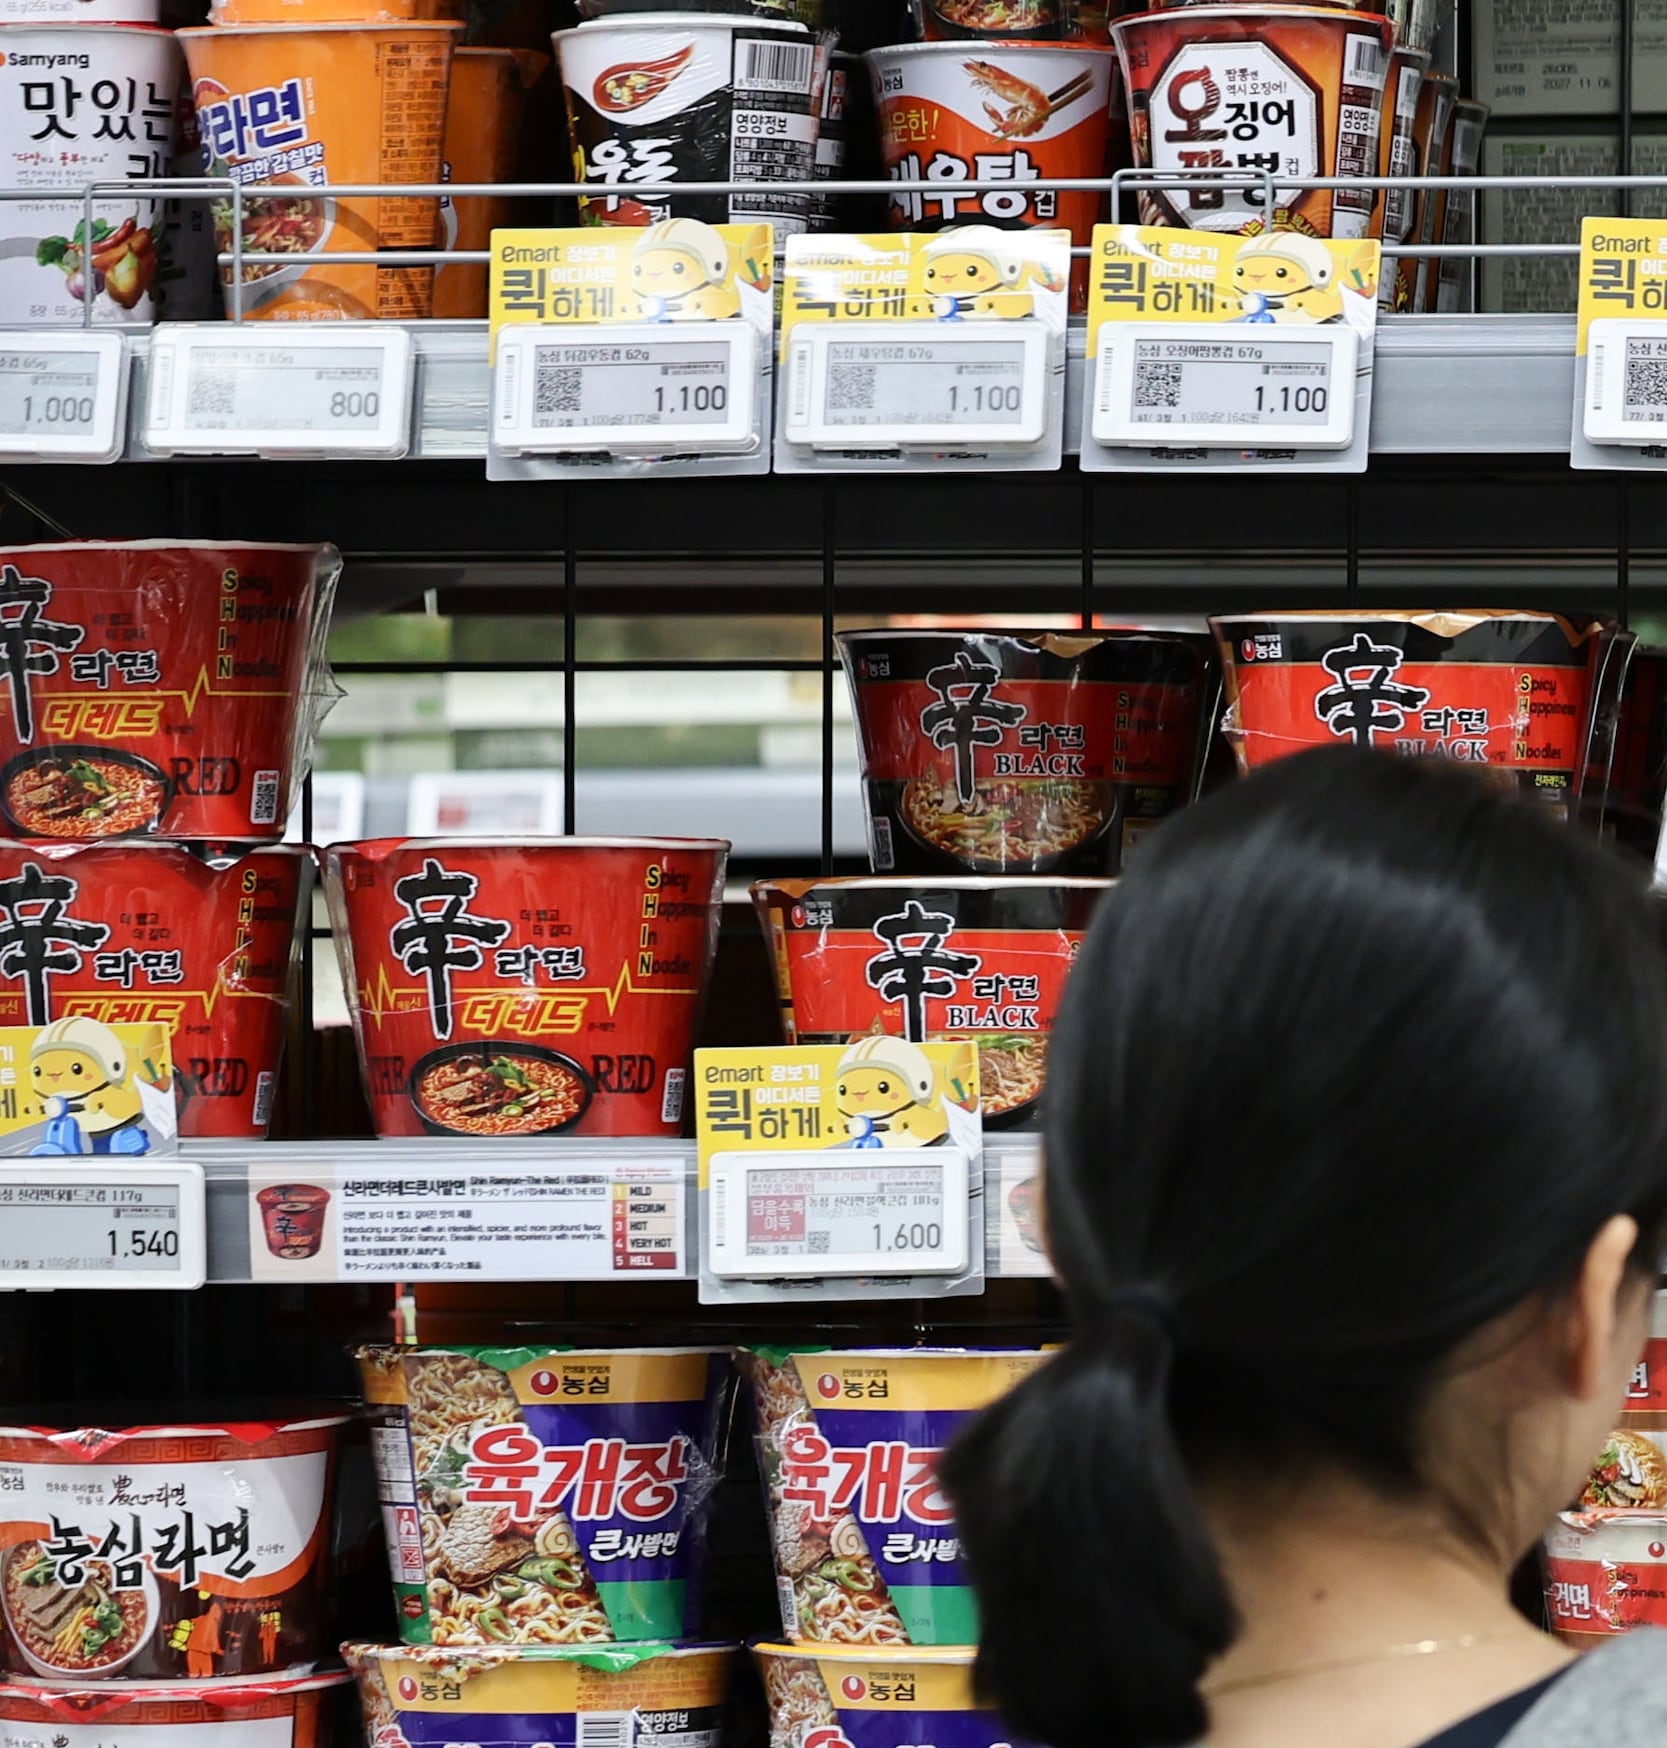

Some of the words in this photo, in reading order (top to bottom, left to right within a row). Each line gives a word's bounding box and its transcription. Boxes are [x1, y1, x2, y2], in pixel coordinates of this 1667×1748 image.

[8, 51, 90, 69] Samyang
[735, 112, 790, 134] 영양정보
[1592, 234, 1652, 255] emart
[21, 396, 94, 425] 1,000
[330, 392, 380, 420] 800
[654, 385, 727, 413] 1,100
[1253, 385, 1328, 414] 1,100
[72, 651, 161, 687] 라면
[42, 699, 165, 739] 더레드
[922, 652, 1025, 802] 辛
[1420, 708, 1488, 737] 라면
[1018, 723, 1086, 751] 라면
[173, 757, 240, 797] RED
[994, 753, 1086, 778] BLACK
[394, 859, 509, 1039] 辛
[497, 948, 586, 983] 라면
[461, 995, 587, 1036] 더레드
[945, 1005, 1040, 1029] BLACK
[591, 1055, 656, 1095] RED
[629, 1204, 666, 1214] MEDIUM
[107, 1229, 180, 1257] 1,540
[871, 1223, 942, 1250] 1,600
[630, 1256, 654, 1266] HELL
[561, 1375, 609, 1395] 농심
[464, 1426, 687, 1518] 육개장
[590, 1528, 680, 1561] 큰사발면
